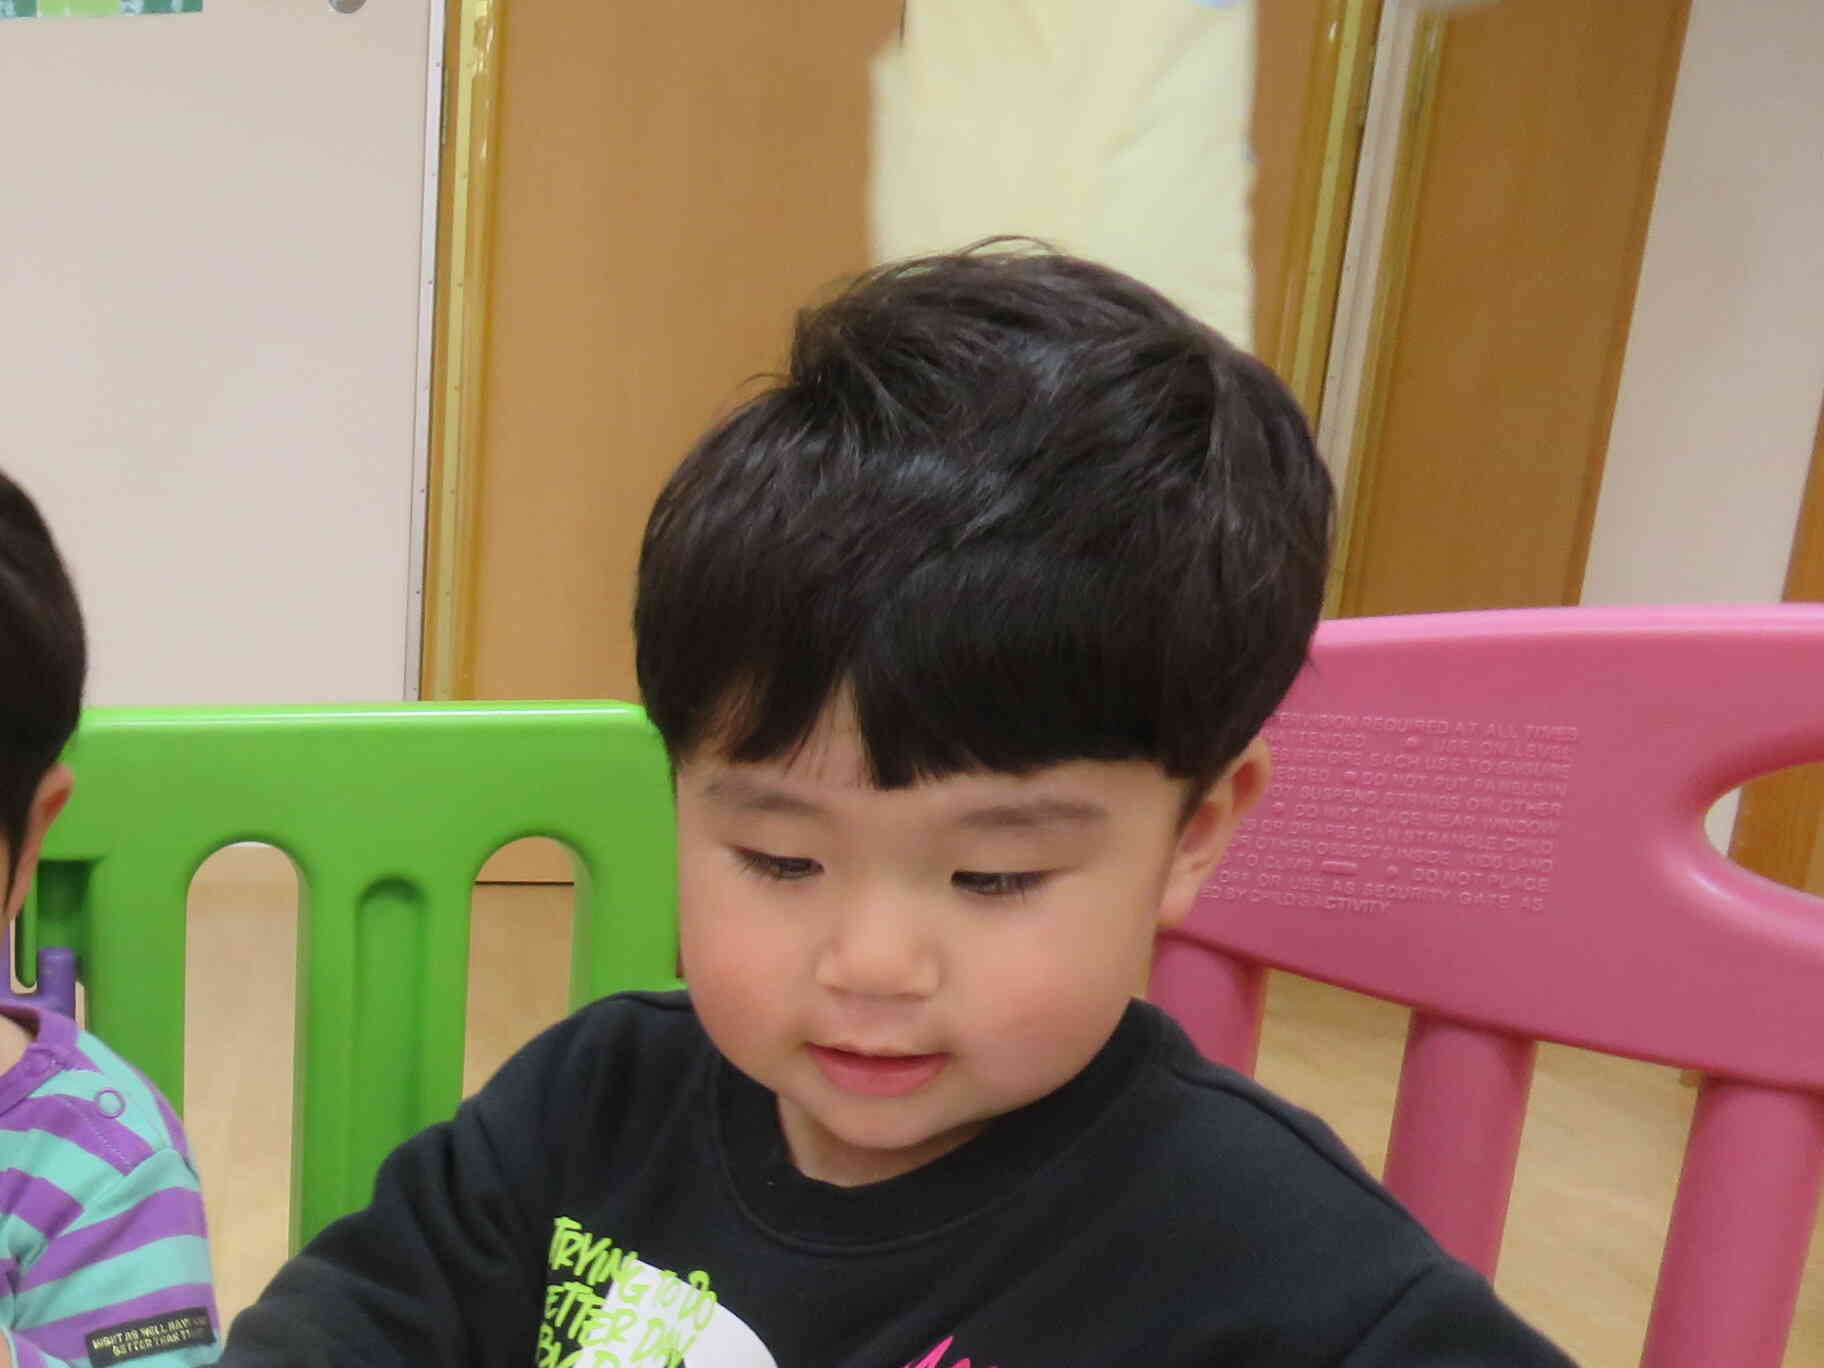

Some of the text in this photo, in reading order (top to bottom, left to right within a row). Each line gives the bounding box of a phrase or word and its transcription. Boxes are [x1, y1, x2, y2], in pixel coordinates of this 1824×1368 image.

[1361, 715, 1449, 734] REQUIRED
[1455, 720, 1480, 736] AT
[1486, 722, 1519, 738] ALL
[1442, 868, 1482, 885] NOT
[548, 1216, 650, 1305] TRYING
[544, 1280, 640, 1347] ETTER
